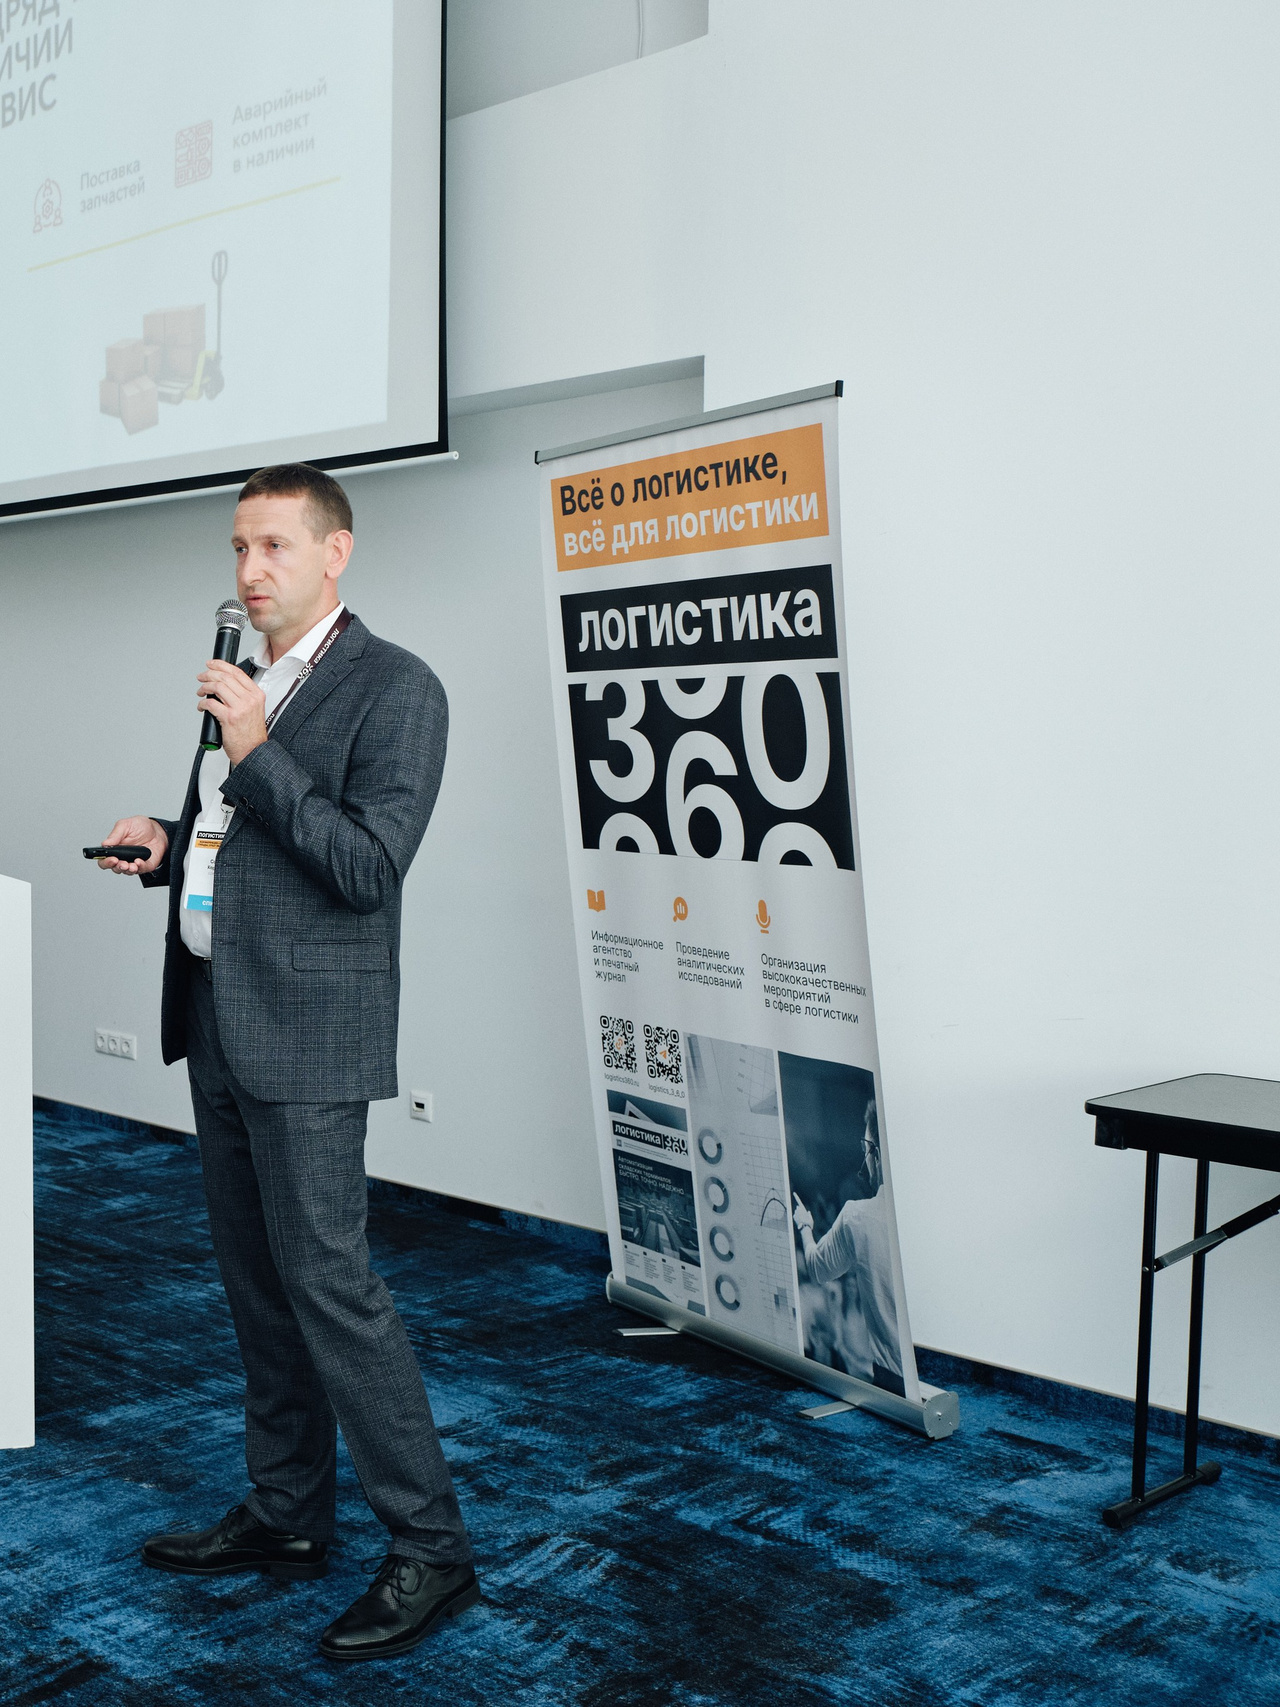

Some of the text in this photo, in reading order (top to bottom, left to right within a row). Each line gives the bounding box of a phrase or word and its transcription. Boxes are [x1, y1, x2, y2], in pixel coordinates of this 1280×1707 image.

[232, 76, 328, 125] Аварийный
[232, 112, 311, 149] комплект
[233, 136, 315, 174] в наличии
[80, 158, 141, 191] Поставка
[80, 175, 146, 214] запчастей
[560, 452, 788, 516] Всё о логистике,
[563, 491, 819, 556] всё для логистики
[591, 930, 664, 951] Информационное
[592, 944, 633, 959] агентство
[676, 941, 730, 961] Проведение
[593, 958, 640, 973] и печатный
[677, 957, 746, 977] аналитических
[760, 953, 827, 975] Организация
[595, 970, 627, 983] журнал
[678, 971, 743, 990] исследований
[762, 970, 867, 997] высококачественных
[763, 984, 832, 1004] мероприятий
[765, 998, 859, 1024] в сфере логистики
